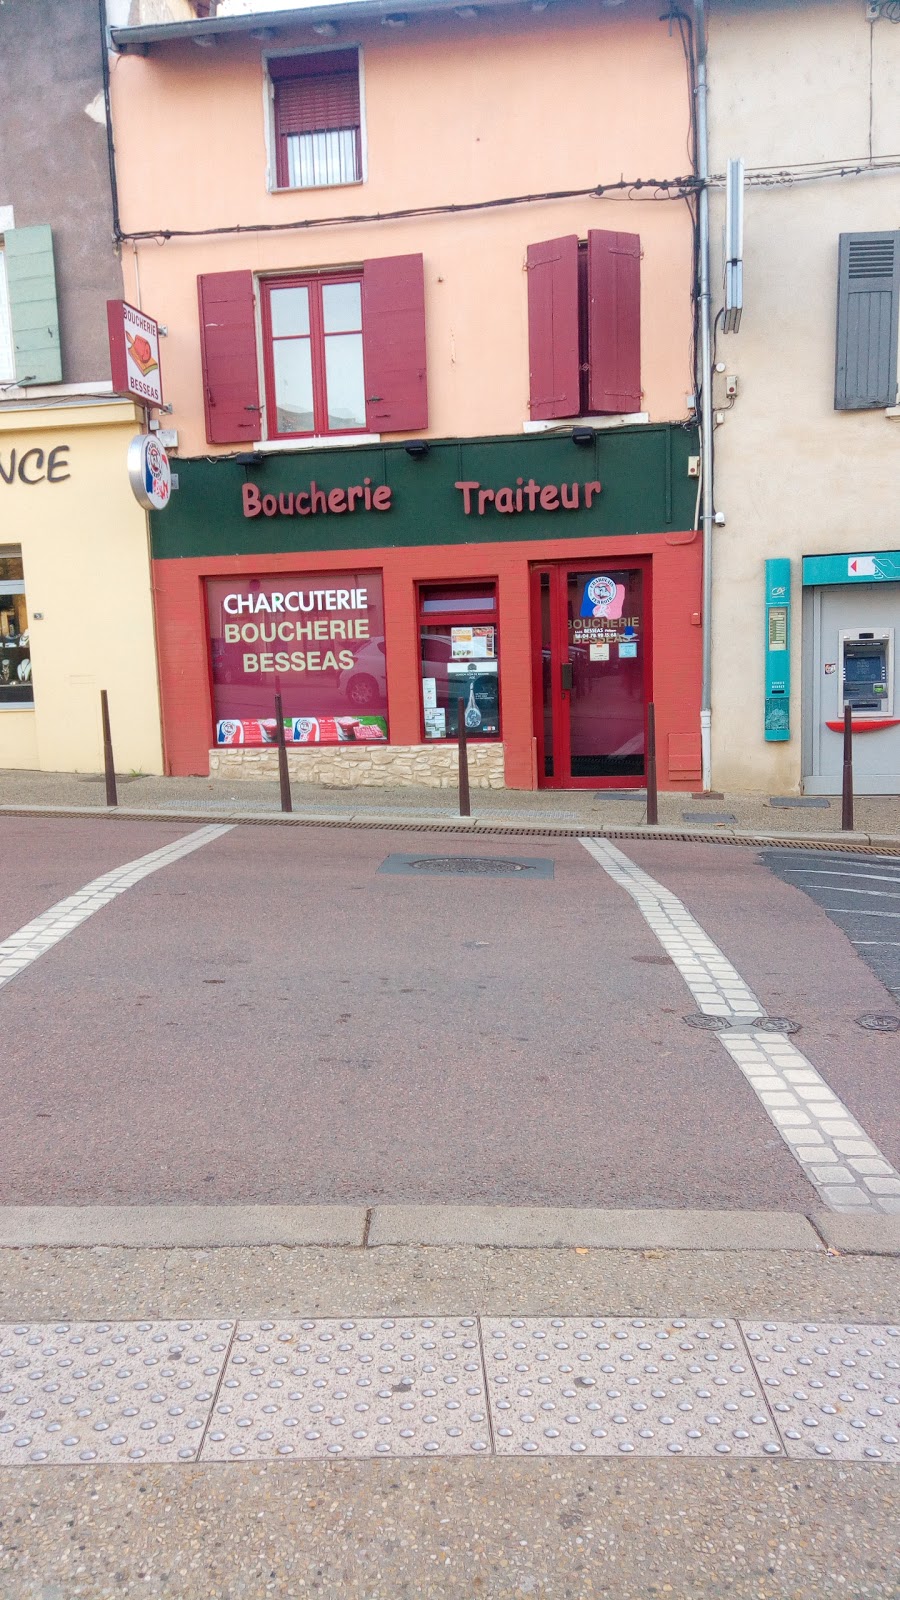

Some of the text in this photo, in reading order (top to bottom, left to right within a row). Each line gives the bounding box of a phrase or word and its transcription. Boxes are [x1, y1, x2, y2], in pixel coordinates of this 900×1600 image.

[123, 307, 157, 337] BOUCHERIE
[130, 376, 159, 400] BESSEAS
[241, 477, 601, 519] Boucherie Traiteur
[223, 588, 368, 615] CHARCUTERIE
[224, 619, 370, 644] BOUCHERIE
[243, 650, 355, 673] BESSEAS
